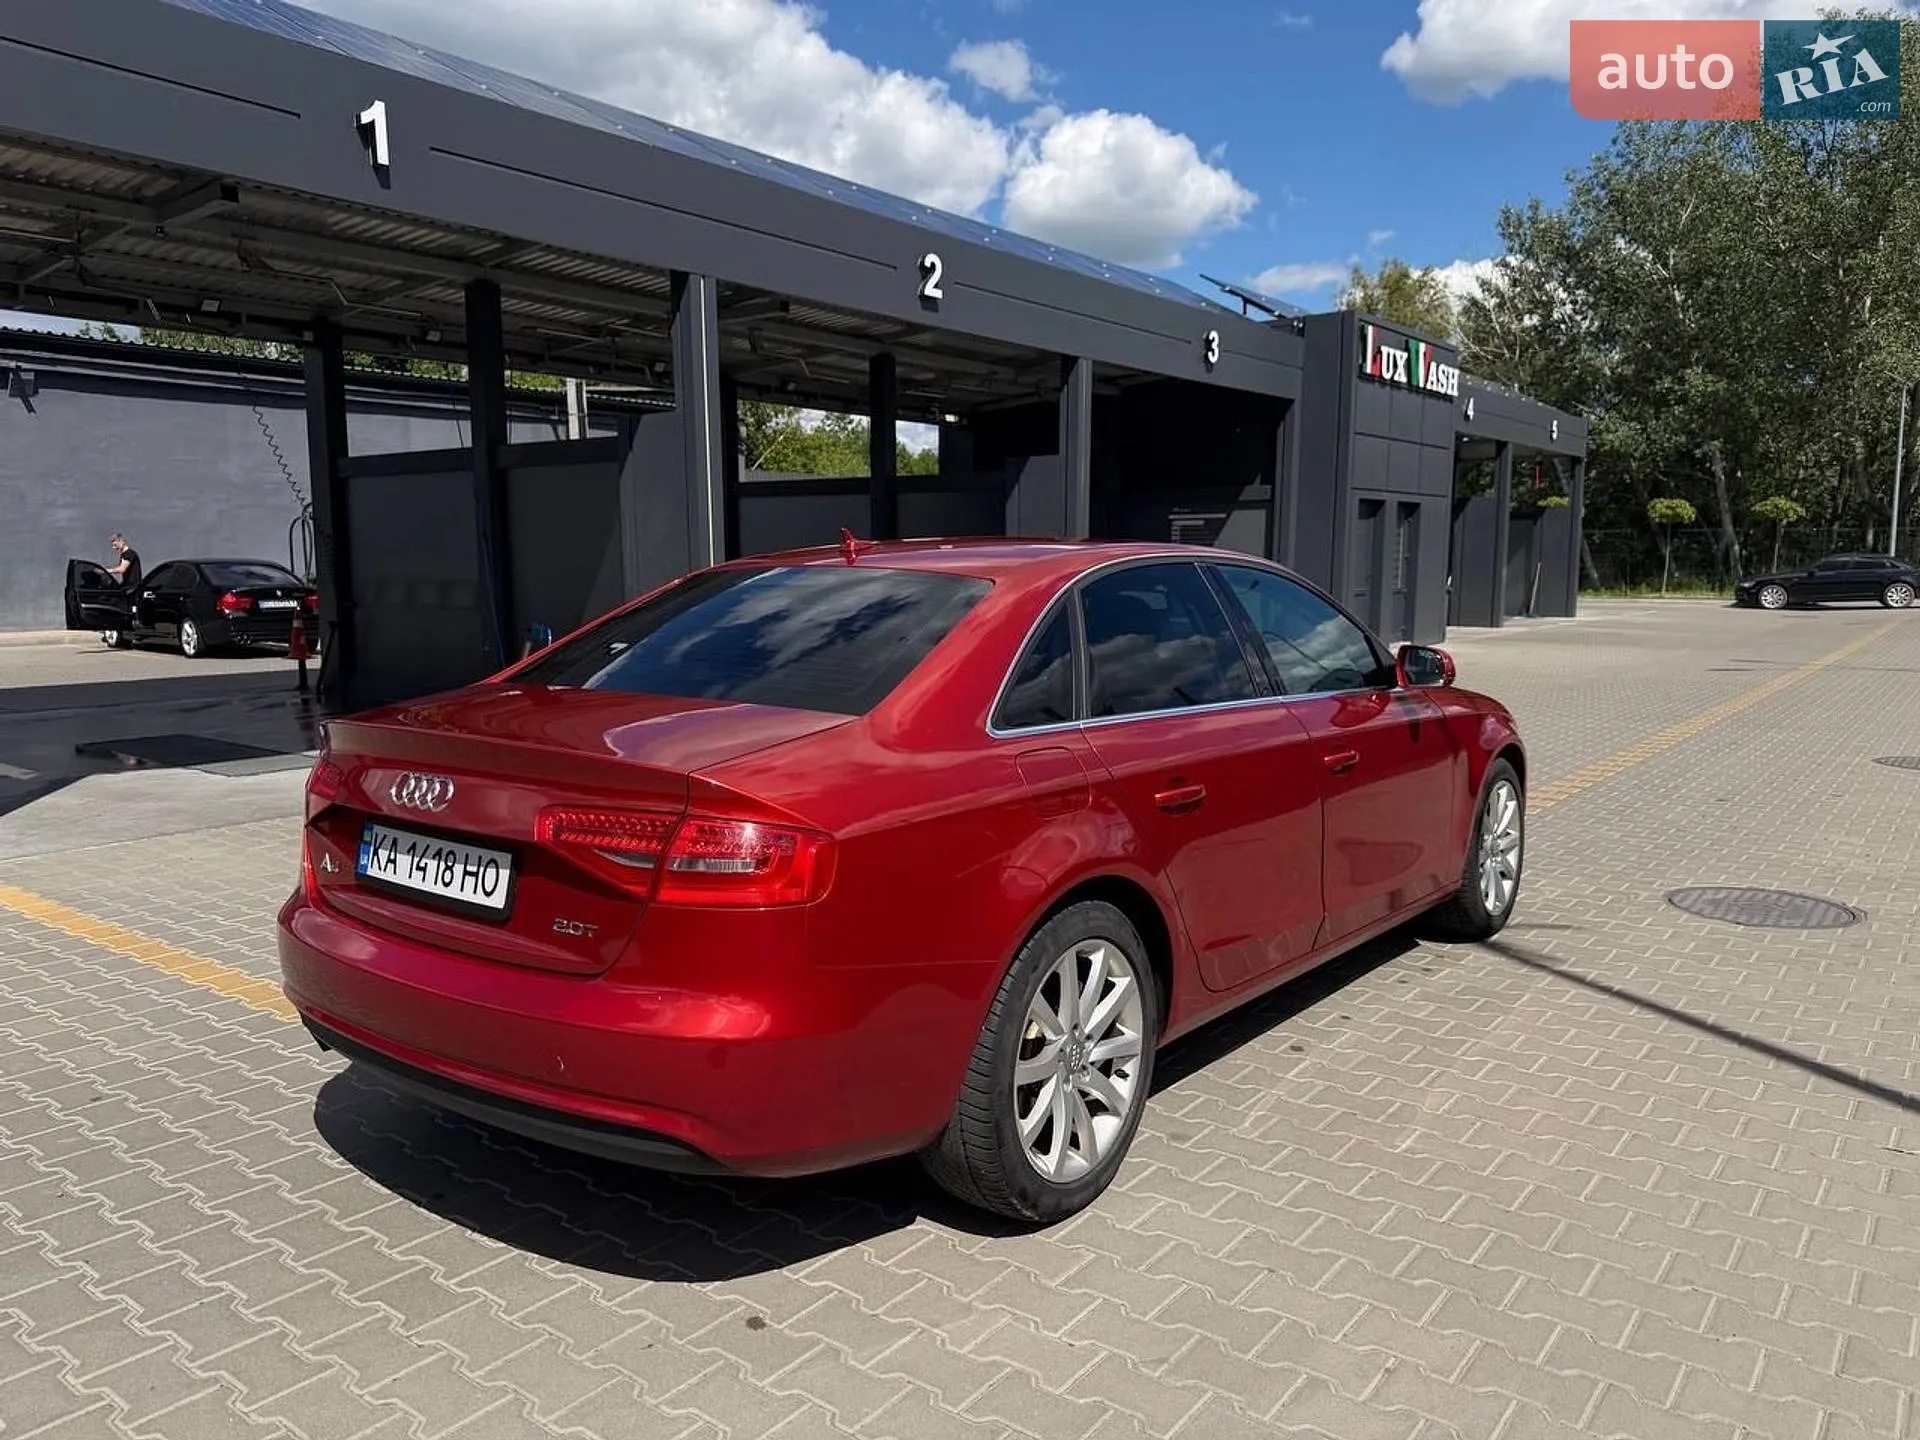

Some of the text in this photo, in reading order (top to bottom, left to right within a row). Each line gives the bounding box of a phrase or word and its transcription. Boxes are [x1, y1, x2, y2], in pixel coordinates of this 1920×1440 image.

[360, 99, 390, 167] 1
[923, 253, 943, 299] 2
[1207, 330, 1219, 364] 3
[1466, 397, 1475, 421] 4
[370, 832, 500, 898] KA 1418 HO
